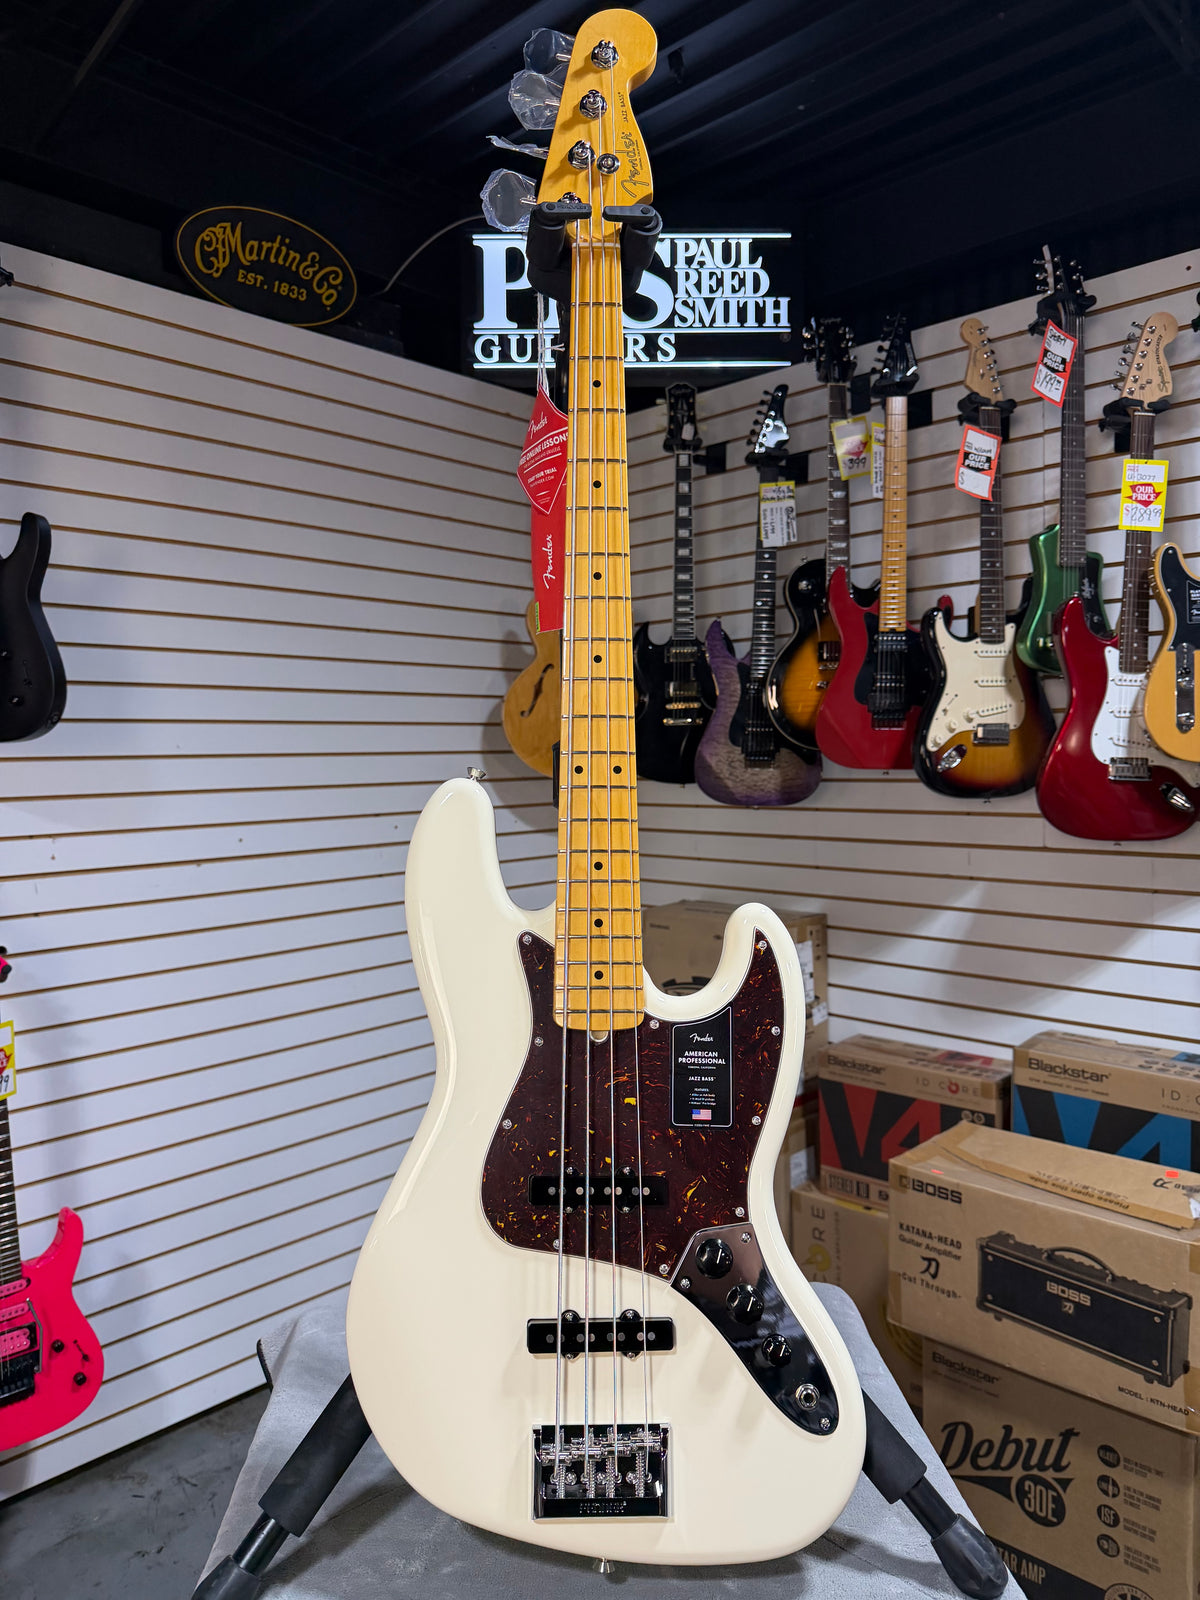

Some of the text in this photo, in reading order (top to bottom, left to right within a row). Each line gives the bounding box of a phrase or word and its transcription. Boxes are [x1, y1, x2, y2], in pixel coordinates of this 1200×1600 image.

[621, 110, 629, 123] JAZZ
[614, 132, 649, 198] Fender
[674, 238, 763, 268] PAUL
[237, 269, 307, 301] EST. 1833
[674, 268, 770, 298] REED
[674, 297, 791, 328] SMITH
[473, 334, 677, 363] GUIRS
[1046, 351, 1063, 364] OUR
[1043, 357, 1065, 372] PRICE
[528, 411, 548, 439] Fender
[964, 459, 990, 470] PRICE
[968, 453, 987, 463] OUR
[1132, 492, 1157, 501] PRICE
[1135, 485, 1154, 494] OUR
[542, 533, 555, 590] Fender
[689, 1033, 714, 1043] Fender
[678, 1057, 726, 1065] PROFESSIONAL
[827, 1055, 886, 1075] Blackstar
[1028, 1057, 1109, 1083] Blackstar
[916, 1077, 930, 1088] ID
[911, 1179, 962, 1204] BOSS
[898, 1222, 962, 1249] KATANA-HEAD
[898, 1234, 962, 1261] Guitar Amplifier
[1046, 1280, 1091, 1306] BOSS
[931, 1351, 999, 1384] Blackstar
[1118, 1385, 1144, 1400] MODEL
[1150, 1398, 1190, 1416] KTN-HEAD
[940, 1421, 1081, 1473] Debut
[1024, 1480, 1059, 1523] 30E
[1100, 1505, 1116, 1526] ISF
[1020, 1558, 1046, 1585] AMP
